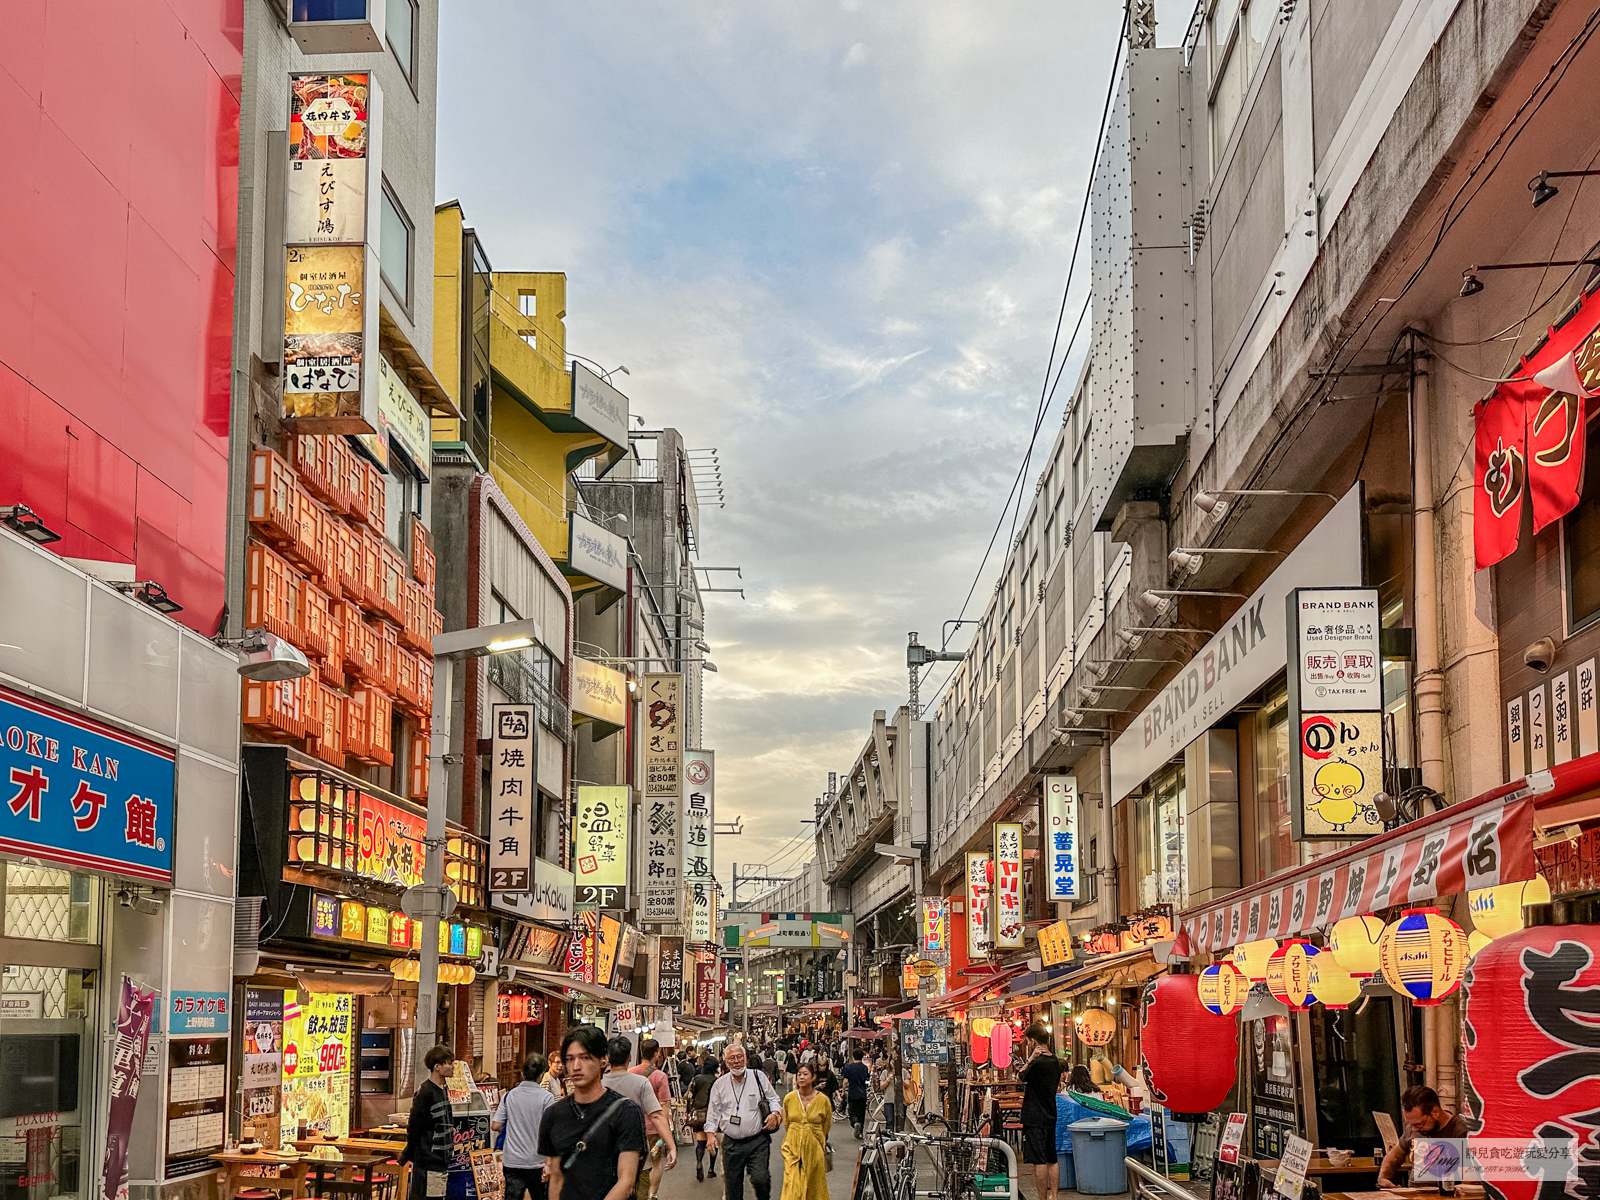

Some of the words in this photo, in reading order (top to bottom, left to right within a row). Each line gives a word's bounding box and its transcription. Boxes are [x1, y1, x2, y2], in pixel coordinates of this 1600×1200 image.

[289, 250, 305, 263] 2F
[289, 283, 361, 315] ひなた
[1302, 602, 1341, 610] BRAND
[1344, 601, 1374, 609] BANK
[1324, 624, 1355, 634] 奢侈品
[1143, 668, 1199, 749] BRAND
[1203, 594, 1267, 694] BANK
[1307, 655, 1337, 669] 販売
[1343, 655, 1374, 669] 買取
[1580, 668, 1593, 712] 砂肝
[1170, 726, 1187, 749] BUY
[1193, 716, 1198, 729] &
[1202, 692, 1226, 721] SELL
[1532, 693, 1543, 750] つくね
[1555, 681, 1567, 743] 手羽先
[502, 715, 527, 734] 牛角
[1304, 721, 1360, 751] のん
[1347, 742, 1380, 757] ちゃん
[72, 746, 119, 781] KAN
[649, 774, 677, 783] 全80席
[7, 765, 157, 850] オケ館
[499, 748, 525, 857] 焼肉牛角
[1064, 783, 1073, 826] レコード
[361, 808, 386, 859] 50
[999, 832, 1009, 859] 煮込み
[1009, 832, 1019, 859] もつ焼
[1053, 831, 1075, 895] 蓄晃堂
[494, 871, 525, 887] 2F
[1000, 861, 1019, 909] ヤリキ
[582, 886, 619, 907] 2F
[647, 897, 676, 906] 全80席
[316, 911, 334, 930] 酒場
[928, 910, 940, 942] DVD
[661, 949, 671, 970] そば
[671, 949, 681, 970] まぜ
[1400, 950, 1428, 962] Asahi
[1440, 930, 1454, 982] アサヒビール
[1291, 955, 1302, 993] アサヒビール
[660, 978, 670, 1000] 焼鳥
[671, 978, 681, 1000] 炭火
[1222, 973, 1231, 1005] アサヒビール
[174, 997, 227, 1014] カラオケ館
[617, 1009, 632, 1021] 80
[185, 1016, 215, 1028] 上野駅前店
[307, 1014, 349, 1035] 飲み放題
[188, 1044, 211, 1056] 料金表
[15, 1112, 60, 1126] LUXURY
[18, 1173, 55, 1187] English
